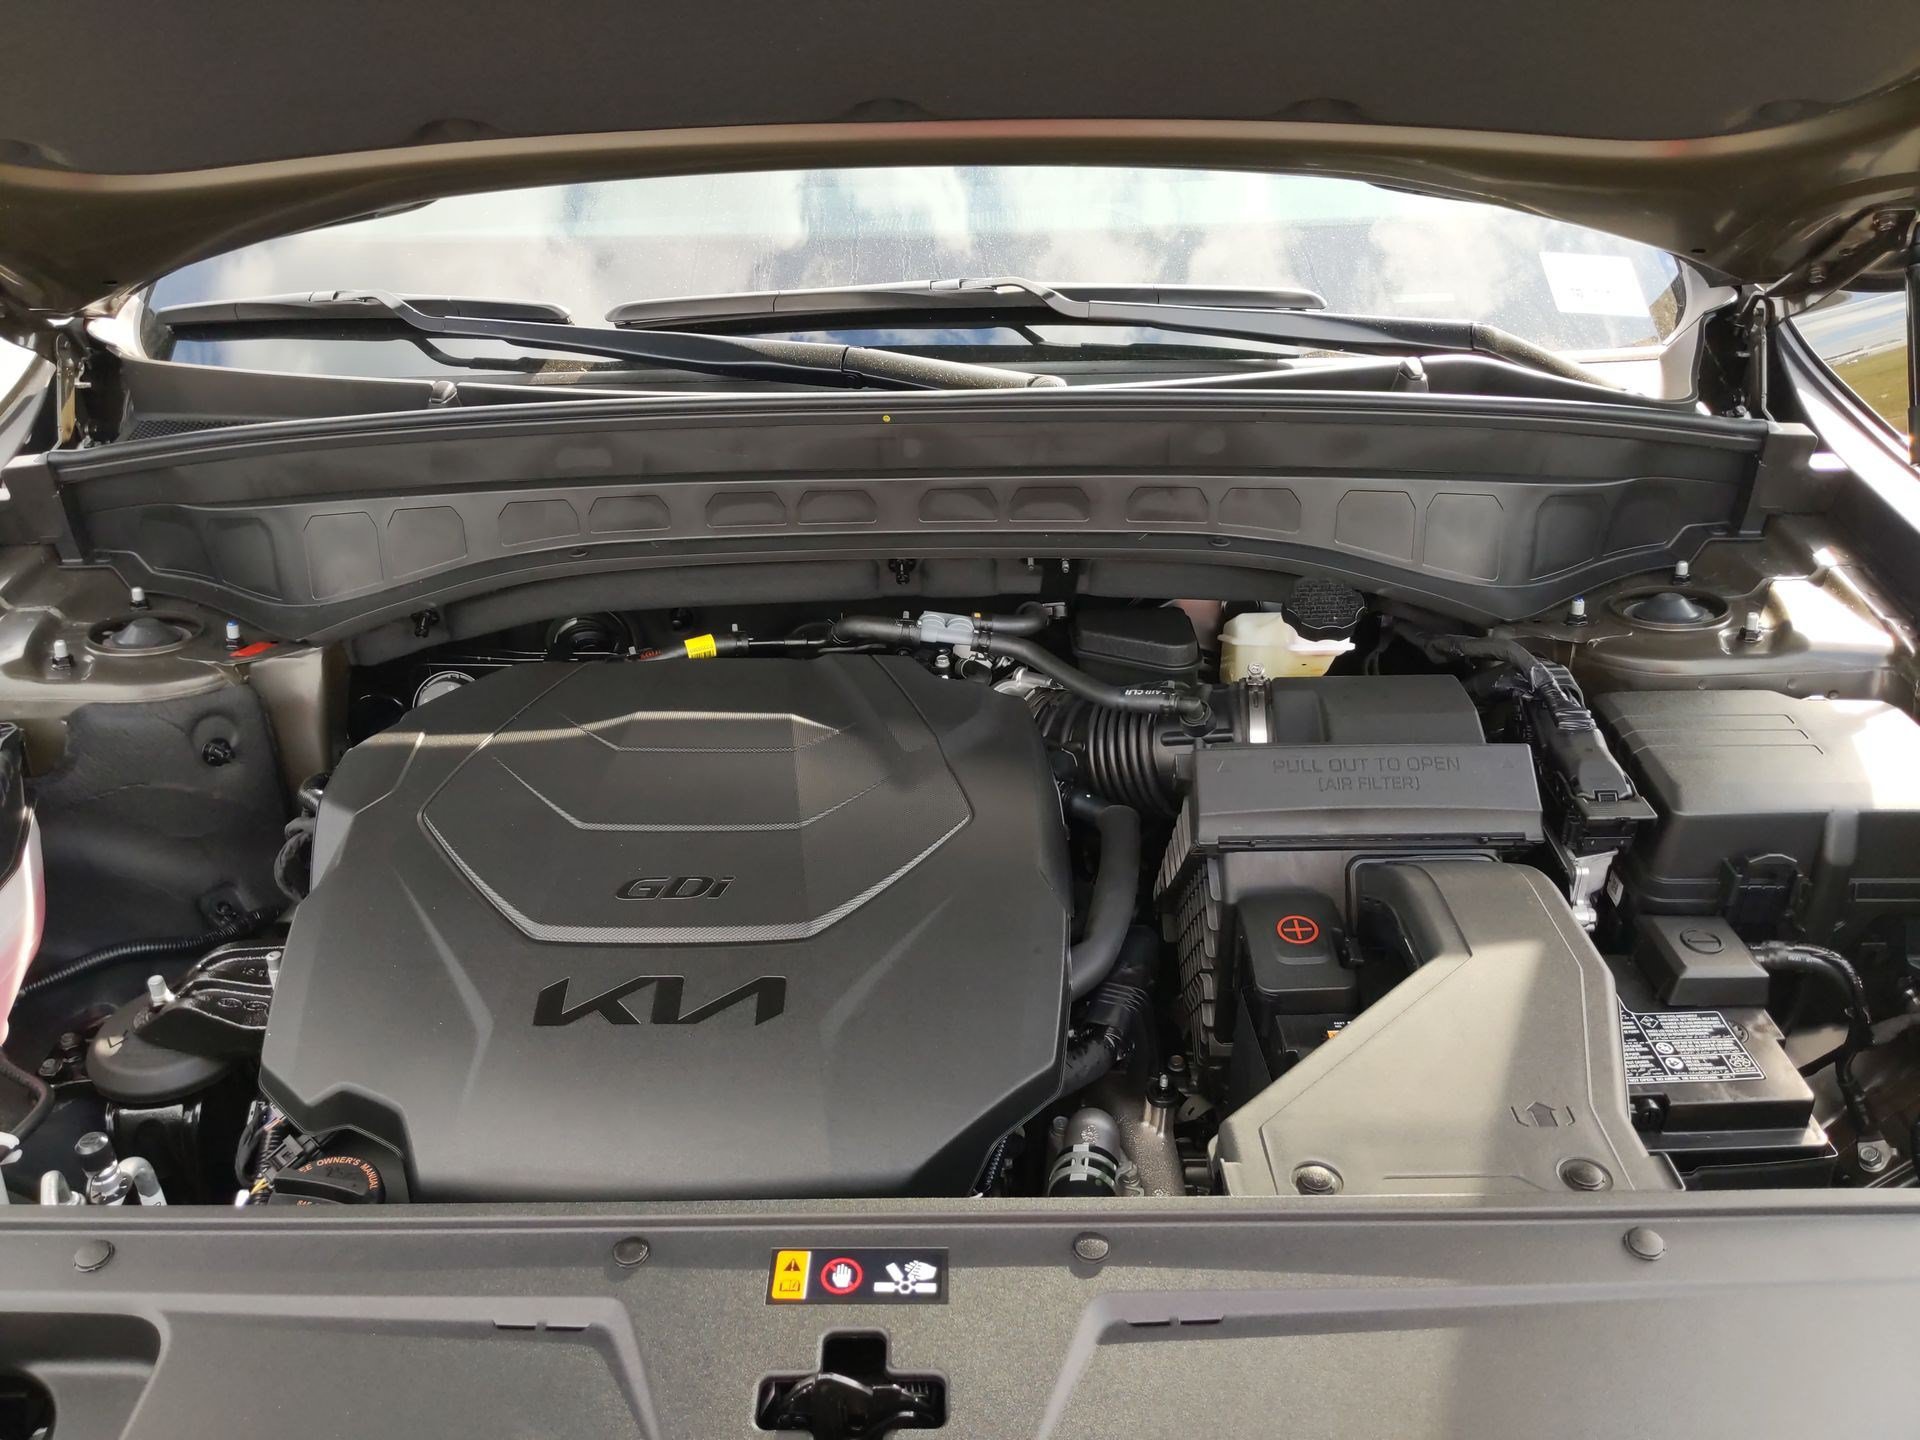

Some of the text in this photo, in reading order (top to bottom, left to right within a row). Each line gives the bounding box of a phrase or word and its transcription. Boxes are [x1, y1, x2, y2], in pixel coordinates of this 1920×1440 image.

[1273, 756, 1461, 774] PULL OUT TO OPEN
[614, 876, 737, 900] GDi
[533, 975, 787, 1026] KIA
[316, 1156, 361, 1167] OWNER'S
[360, 1162, 379, 1190] MANUAL
